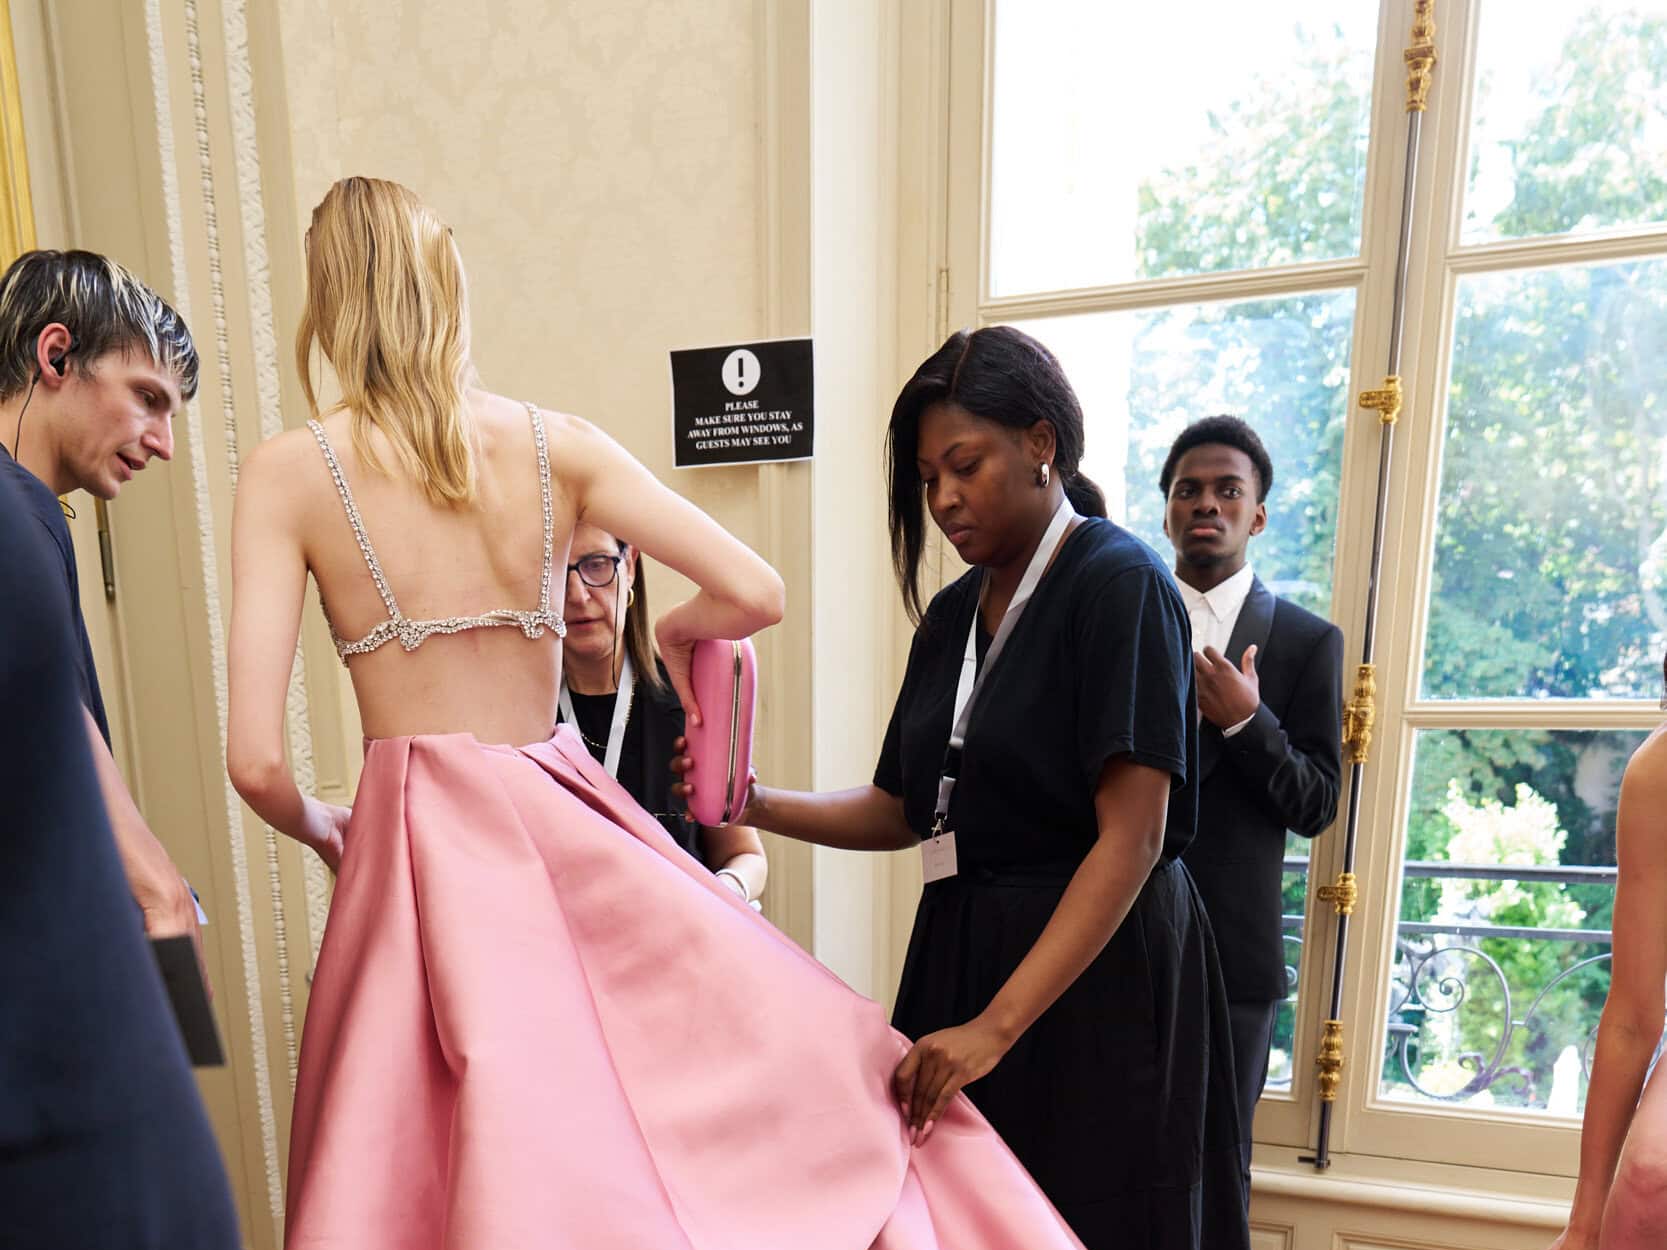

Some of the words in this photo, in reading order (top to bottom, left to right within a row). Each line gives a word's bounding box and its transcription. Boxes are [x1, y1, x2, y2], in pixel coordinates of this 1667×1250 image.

[725, 400, 759, 411] PLEASE
[695, 415, 721, 426] MAKE
[722, 413, 746, 424] SURE
[747, 412, 768, 422] YOU
[769, 410, 792, 420] STAY
[687, 428, 711, 439] AWAY
[713, 426, 739, 437] FROM
[740, 423, 790, 435] WINDOWS,
[791, 422, 803, 431] AS
[695, 439, 730, 450] GUESTS
[731, 437, 752, 447] MAY
[753, 436, 770, 446] SEE
[772, 435, 792, 445] YOU
